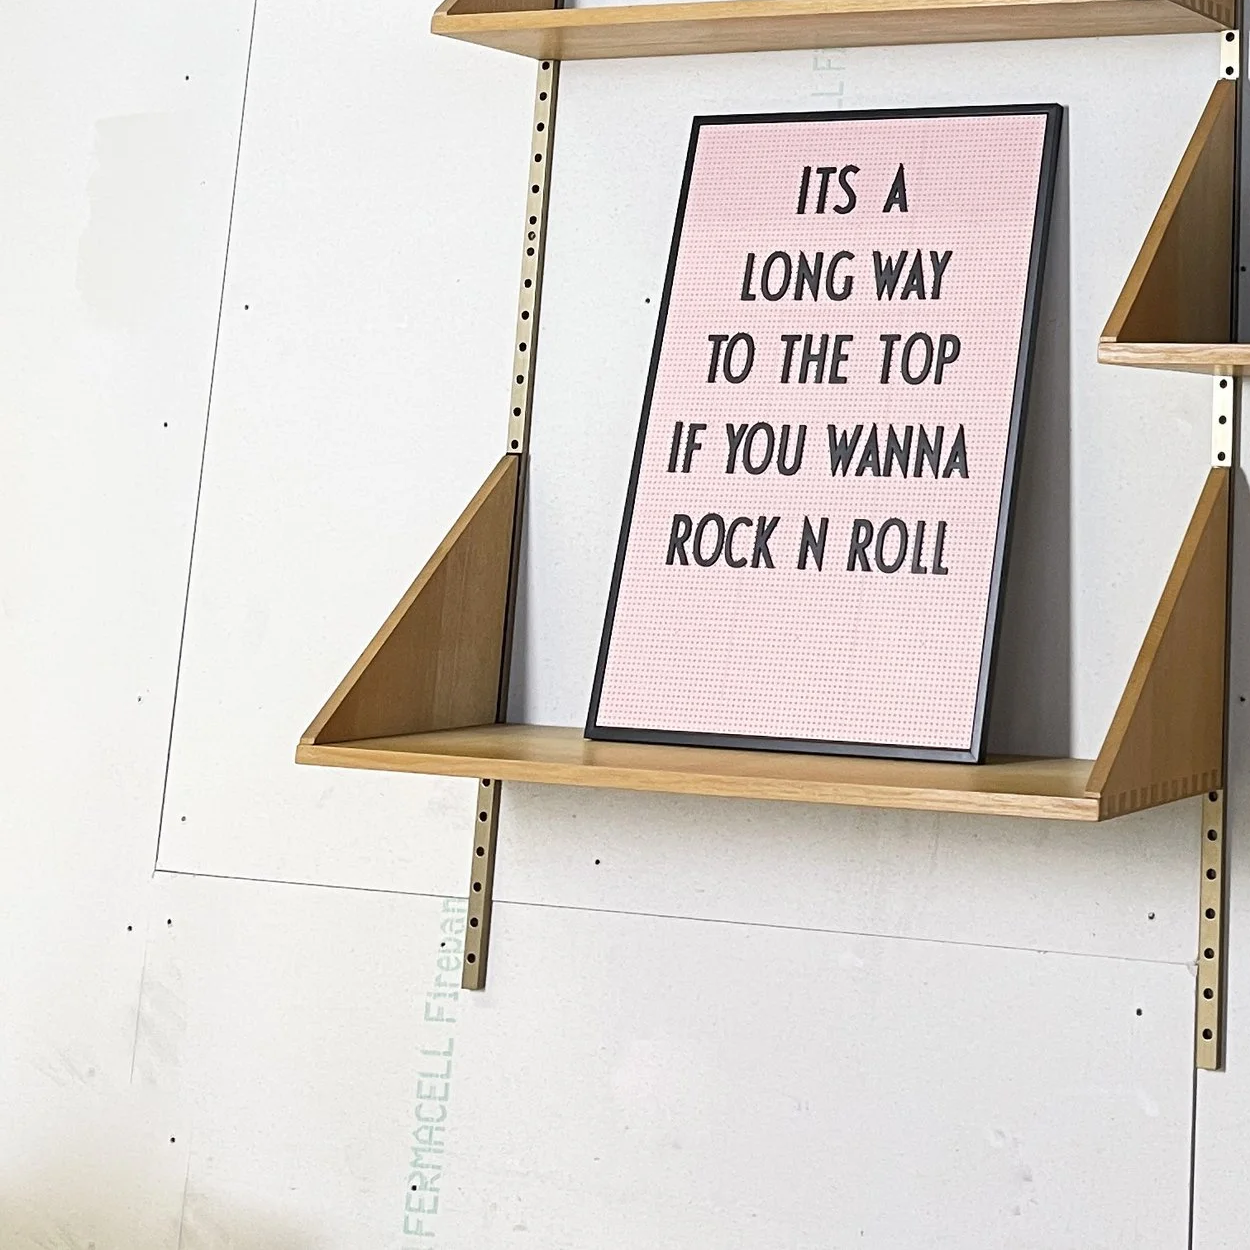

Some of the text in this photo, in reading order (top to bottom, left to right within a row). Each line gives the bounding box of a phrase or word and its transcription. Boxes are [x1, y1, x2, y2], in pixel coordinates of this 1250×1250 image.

[796, 163, 908, 214] ITS A
[740, 249, 953, 302] LONG WAY
[707, 332, 961, 385] TO THE TOP
[667, 421, 970, 479] IF YOU WANNA
[665, 513, 949, 575] ROCK N ROLL
[402, 898, 467, 1238] FERMACELL Firepan
